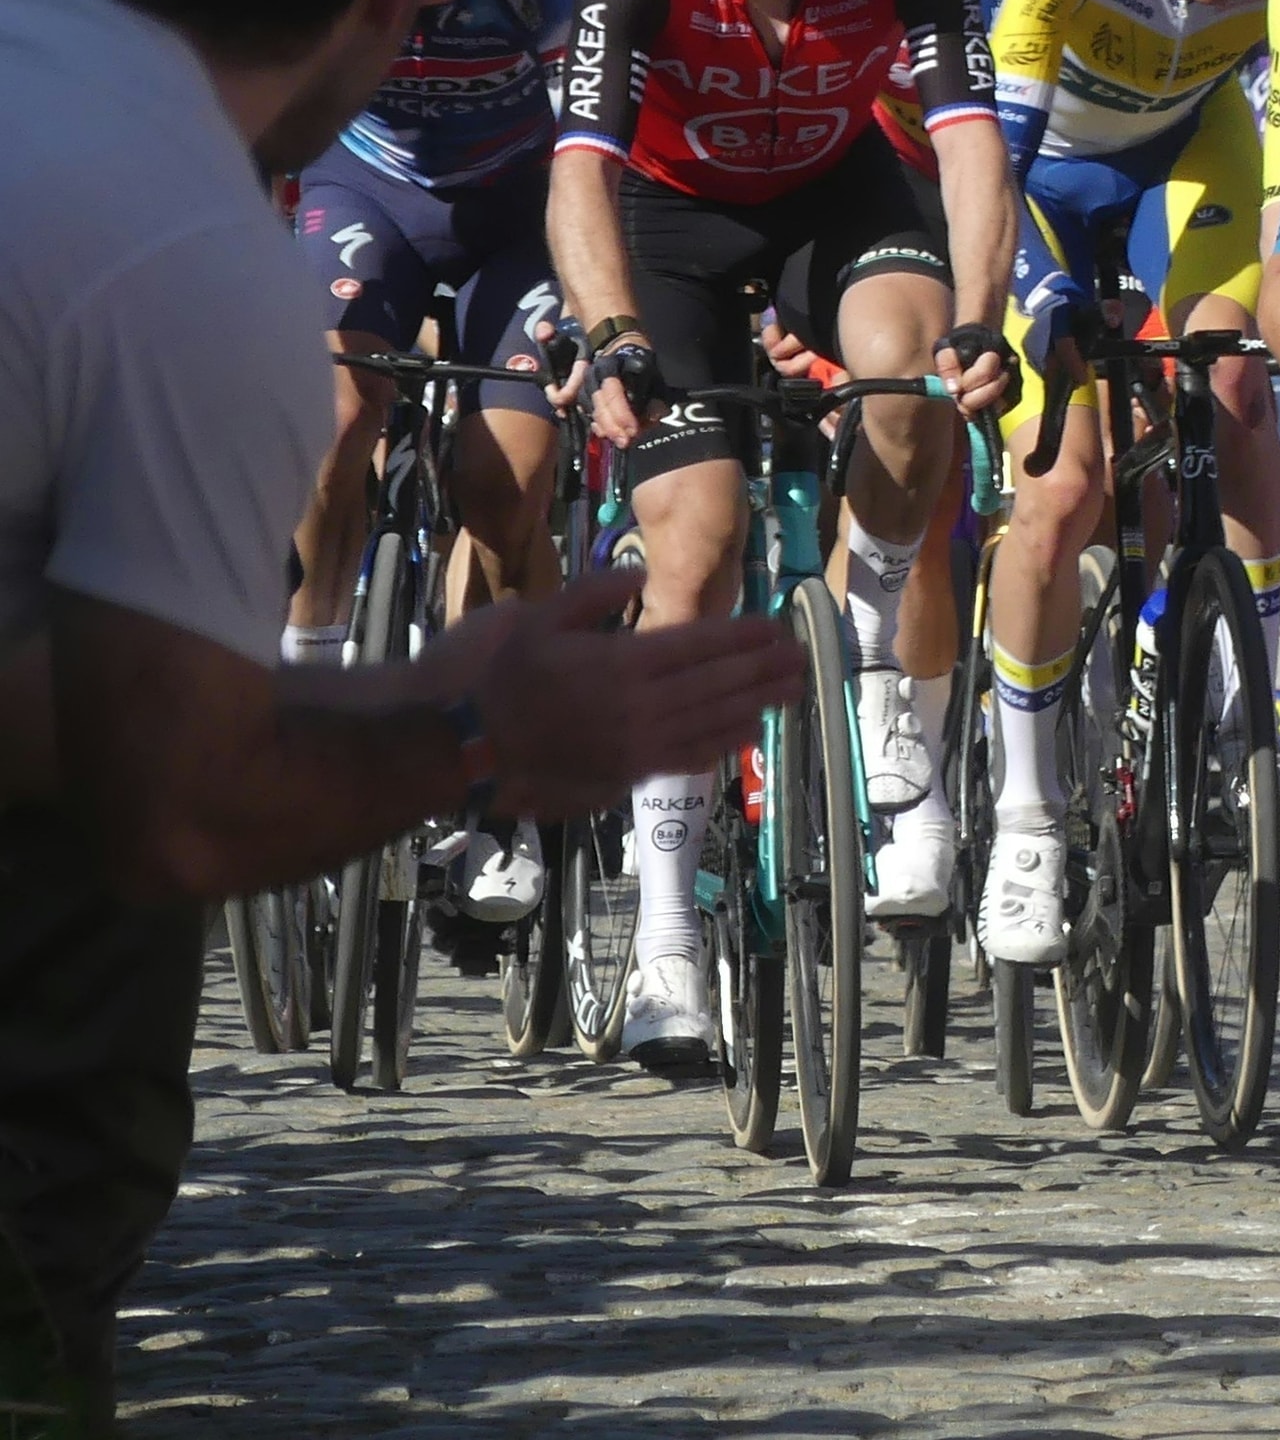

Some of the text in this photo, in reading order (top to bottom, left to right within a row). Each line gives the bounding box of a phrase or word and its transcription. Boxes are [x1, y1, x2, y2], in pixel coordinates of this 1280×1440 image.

[568, 2, 609, 122] ARKEA
[640, 796, 705, 812] ARKEA
[656, 828, 684, 840] B&B
